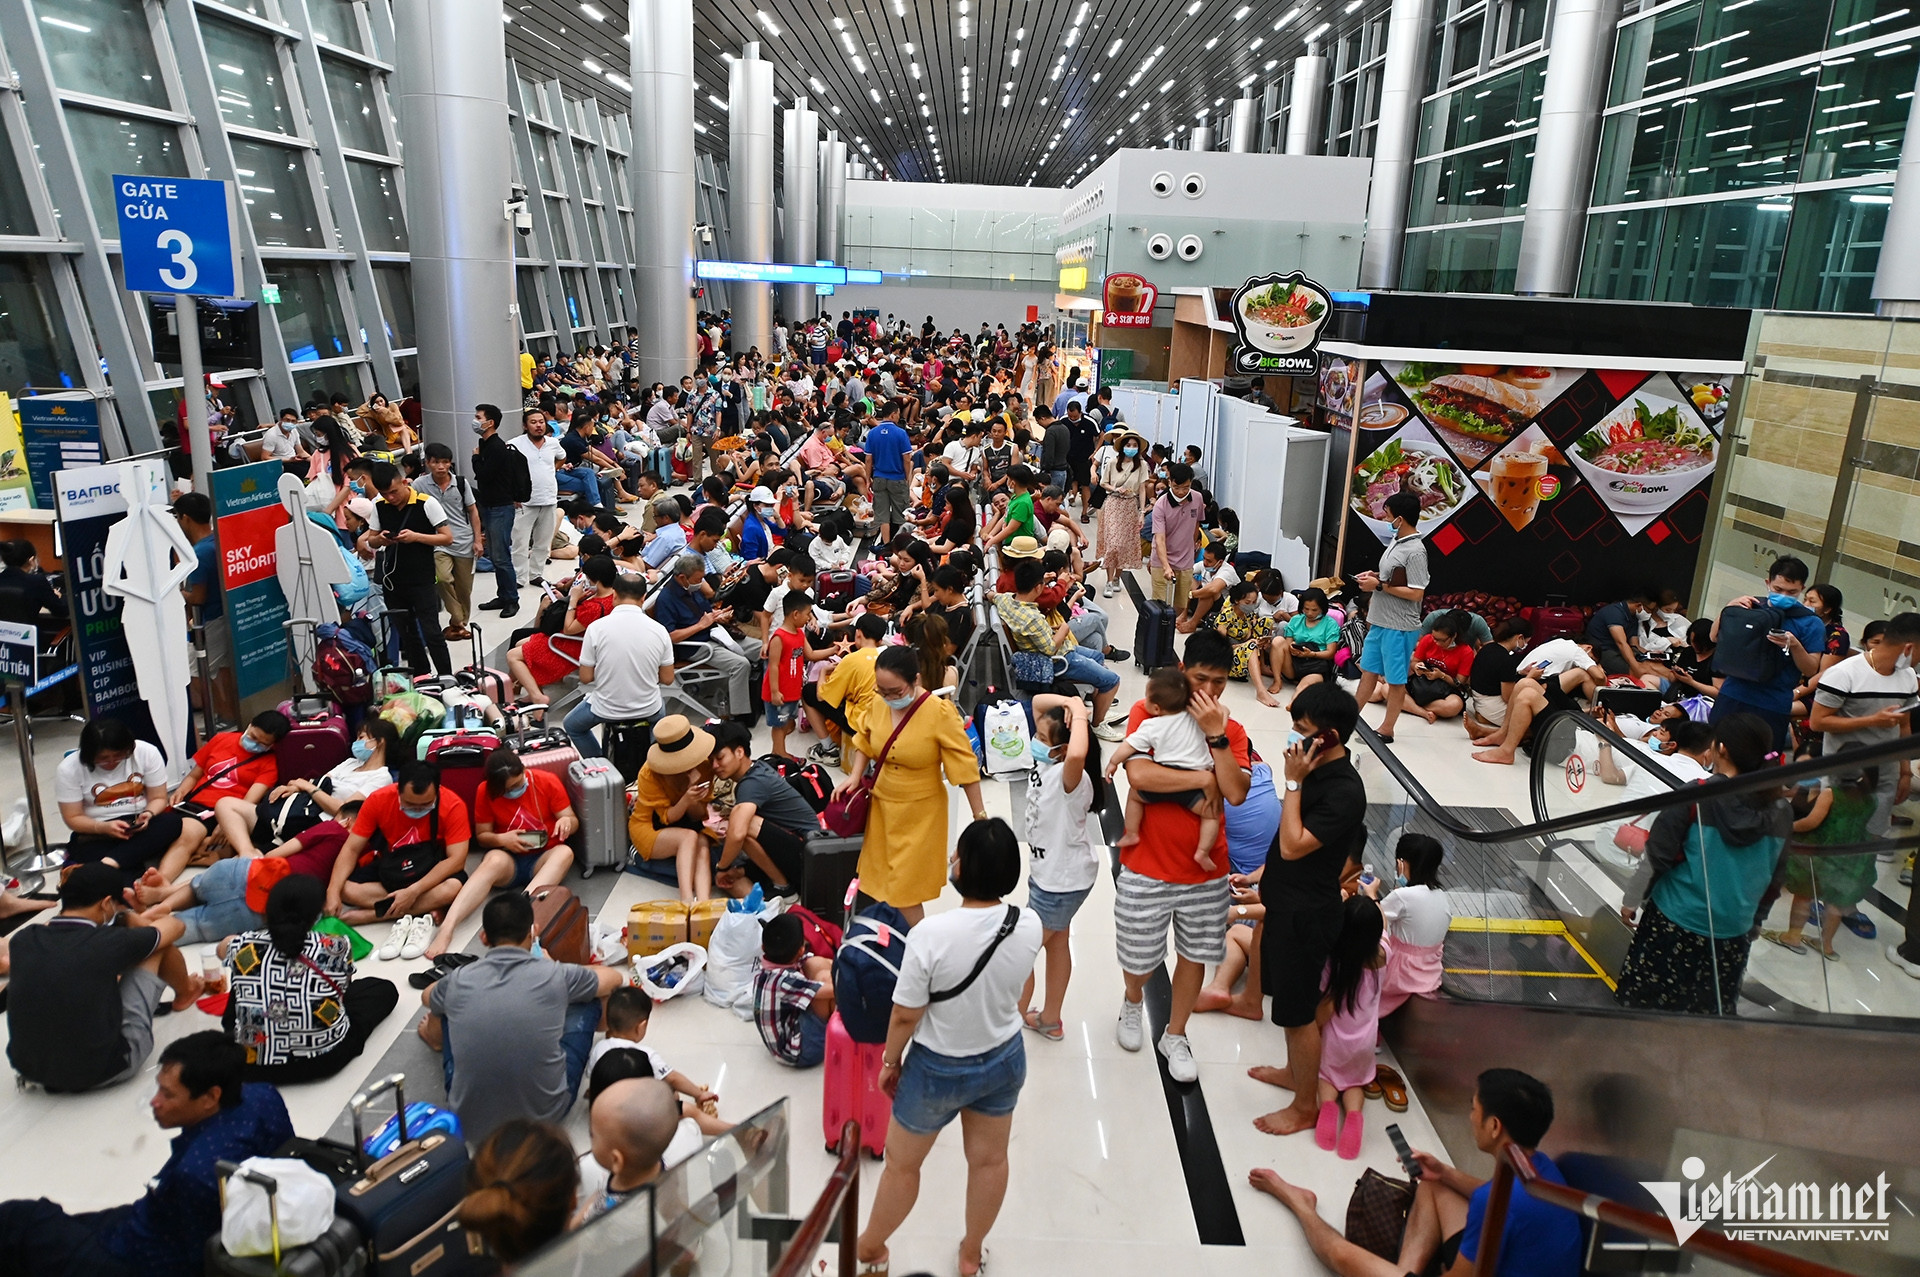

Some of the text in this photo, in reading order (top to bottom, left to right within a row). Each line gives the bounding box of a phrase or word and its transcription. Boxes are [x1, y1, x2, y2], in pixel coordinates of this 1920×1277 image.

[122, 182, 178, 199] GATE
[124, 199, 169, 220] CỬA
[156, 229, 198, 290] 3
[1641, 485, 1669, 494] BOWL
[226, 544, 253, 563] SKY
[88, 649, 107, 662] VIP
[93, 676, 110, 689] CIP
